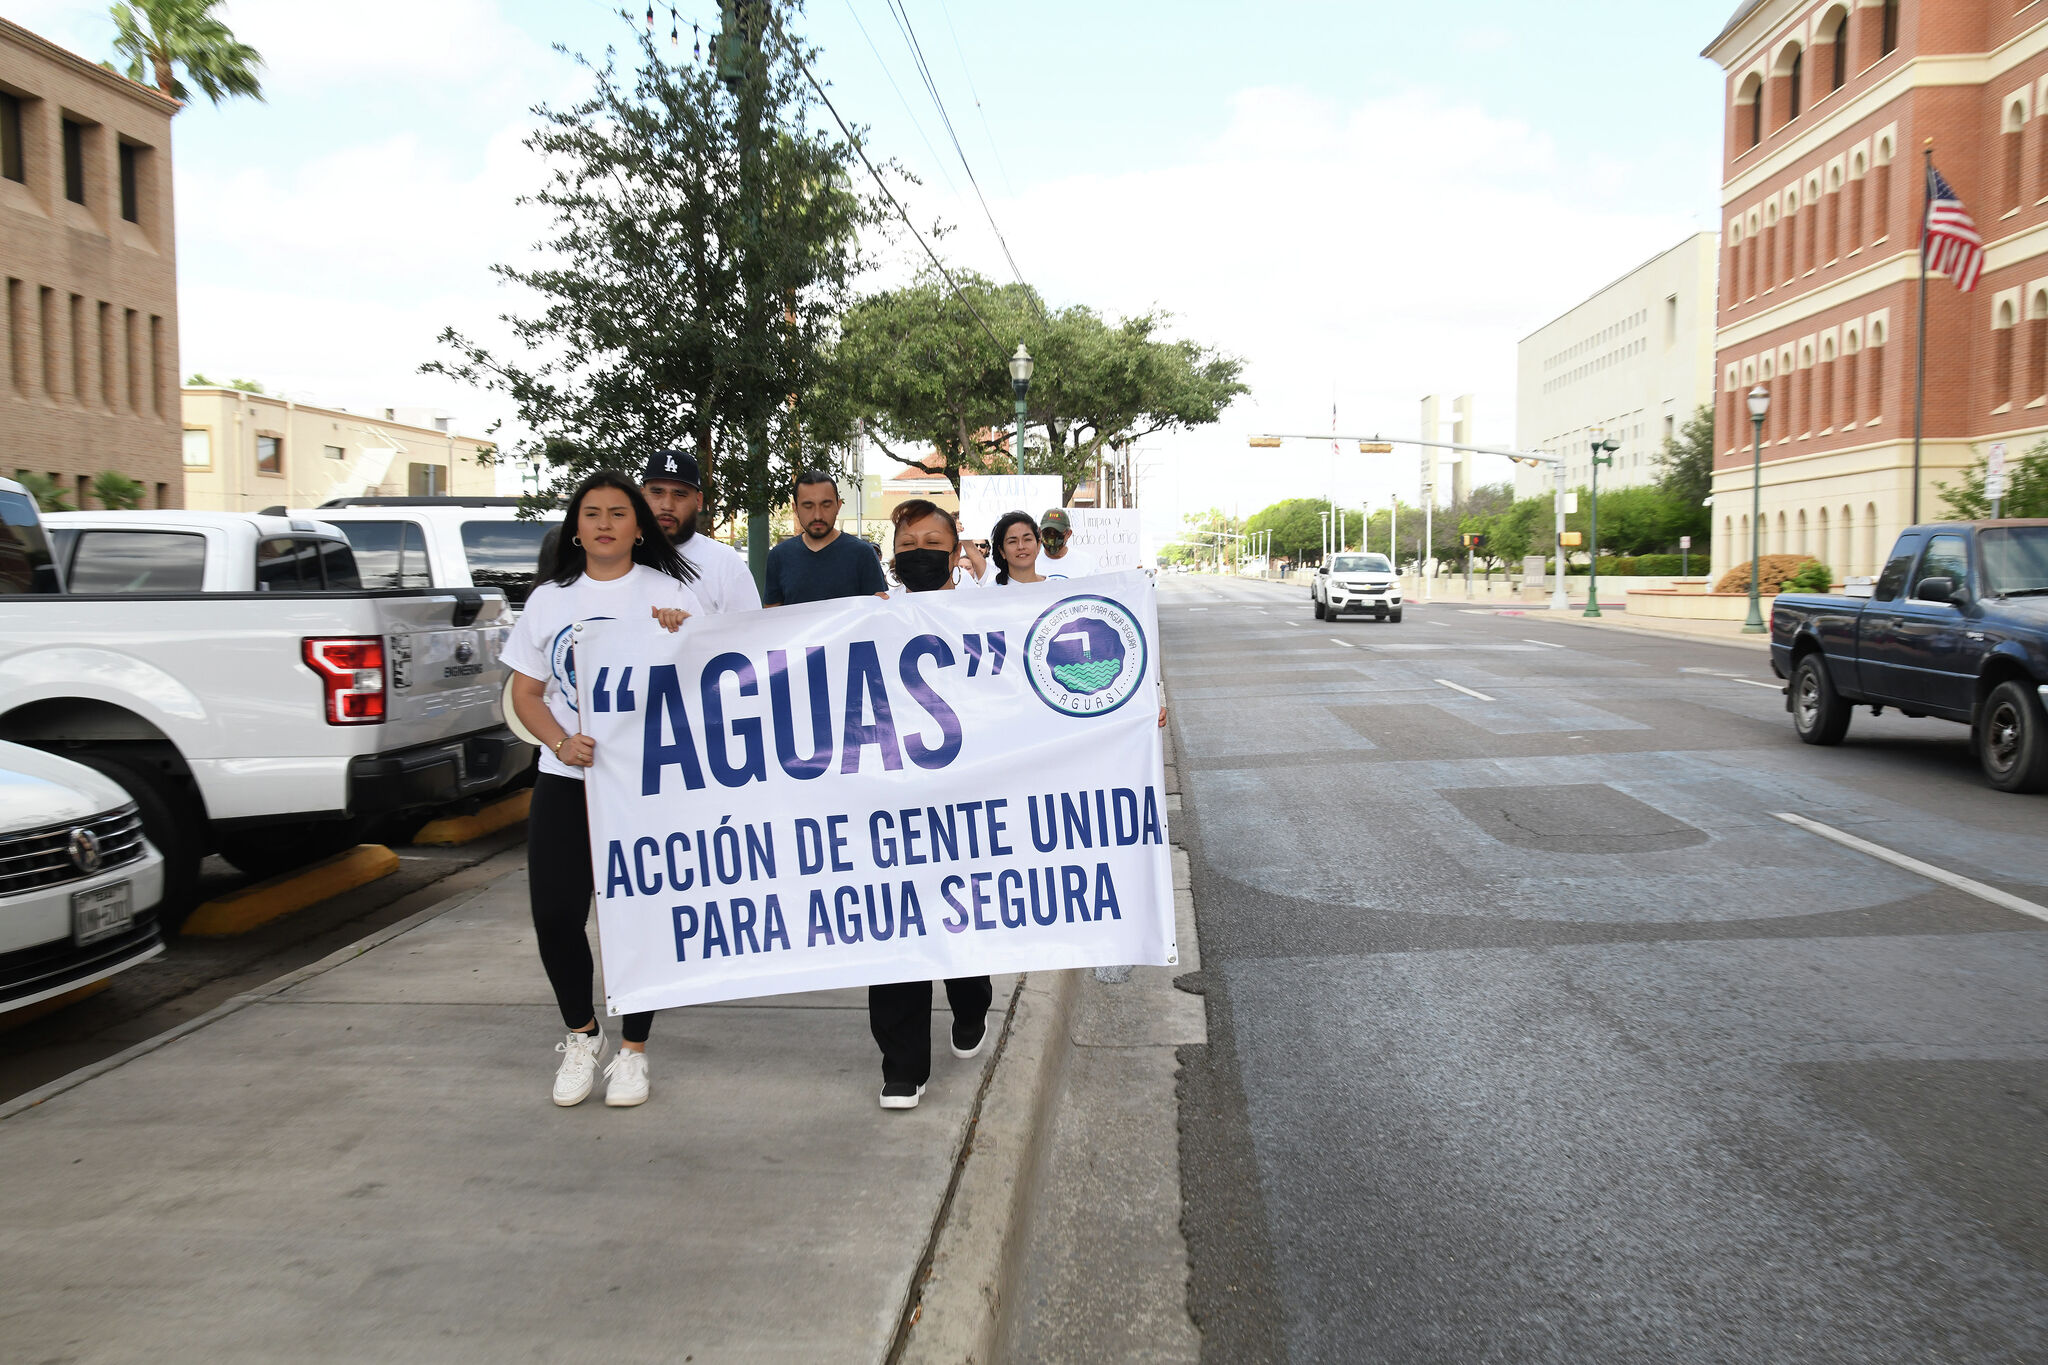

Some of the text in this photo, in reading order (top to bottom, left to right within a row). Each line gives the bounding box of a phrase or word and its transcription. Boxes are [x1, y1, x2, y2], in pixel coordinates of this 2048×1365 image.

[664, 455, 678, 473] LA
[1034, 605, 1137, 661] ACCIÓN DE GENTE UNIDA PARA AGUA SEGURA
[606, 785, 1163, 899] ACCIÓN DE GENTE UNIDA
[671, 862, 1122, 962] PARA AGUA SEGURA
